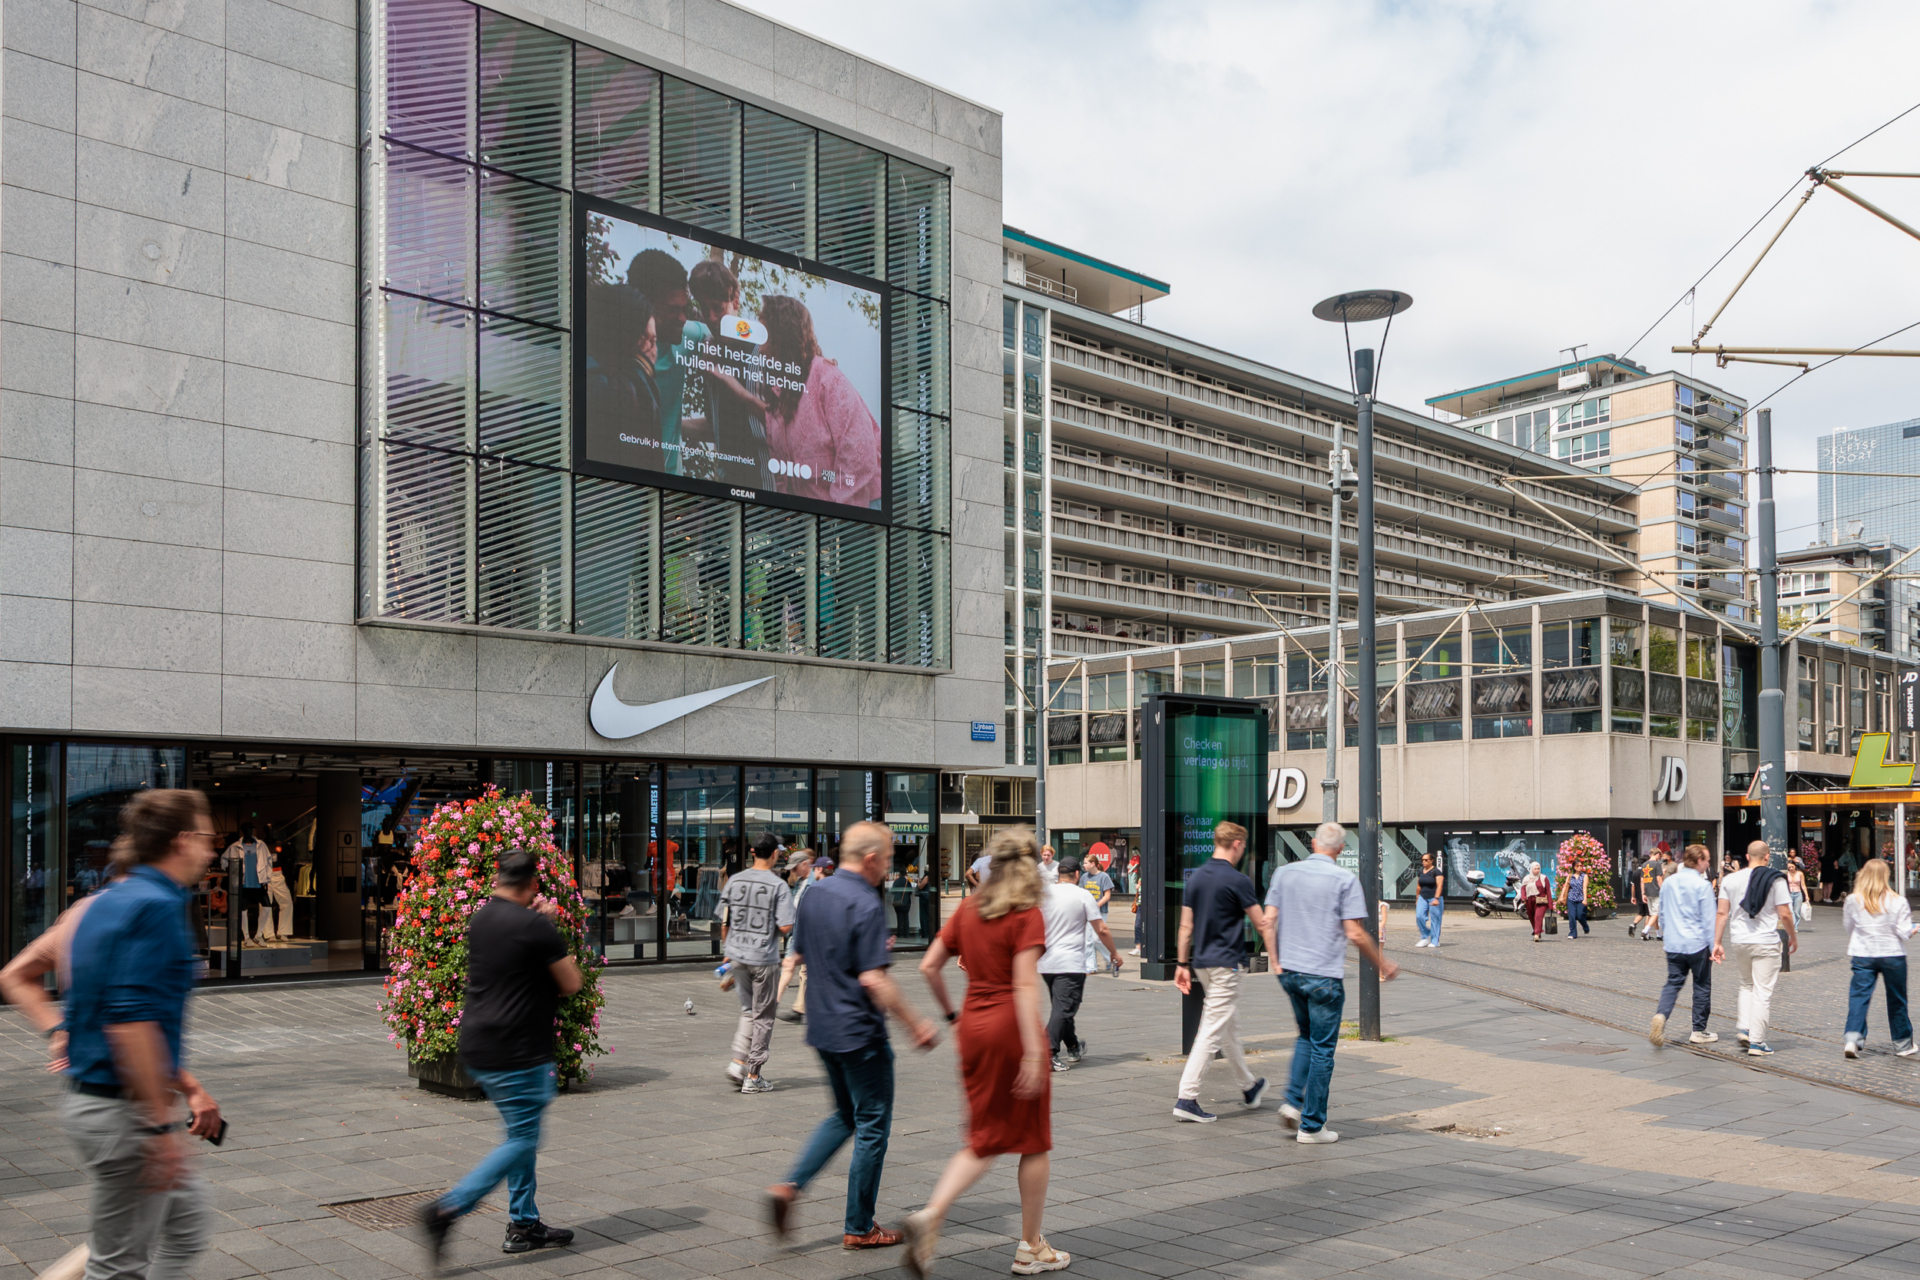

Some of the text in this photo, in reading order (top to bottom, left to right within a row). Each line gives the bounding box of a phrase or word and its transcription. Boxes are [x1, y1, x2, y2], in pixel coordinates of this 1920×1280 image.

[684, 336, 802, 375] is niet hetzelfde als
[675, 350, 809, 394] huilen van het lachen.
[619, 433, 756, 466] Gebruik je stem tegen eenzaamheid.
[730, 488, 756, 499] OCEAN
[1902, 671, 1919, 684] JD
[1183, 737, 1222, 751] Check en
[1183, 754, 1249, 770] verleng op tijd.
[1653, 755, 1688, 802] JD
[865, 771, 873, 813] ATHLETES
[650, 789, 658, 824] ATHLETES
[1183, 814, 1213, 826] Ga naar
[1829, 812, 1838, 826] JD
[912, 824, 929, 833] OAS
[1183, 828, 1216, 840] rotterda
[1183, 843, 1216, 855] paspoor
[1096, 853, 1109, 862] ALE
